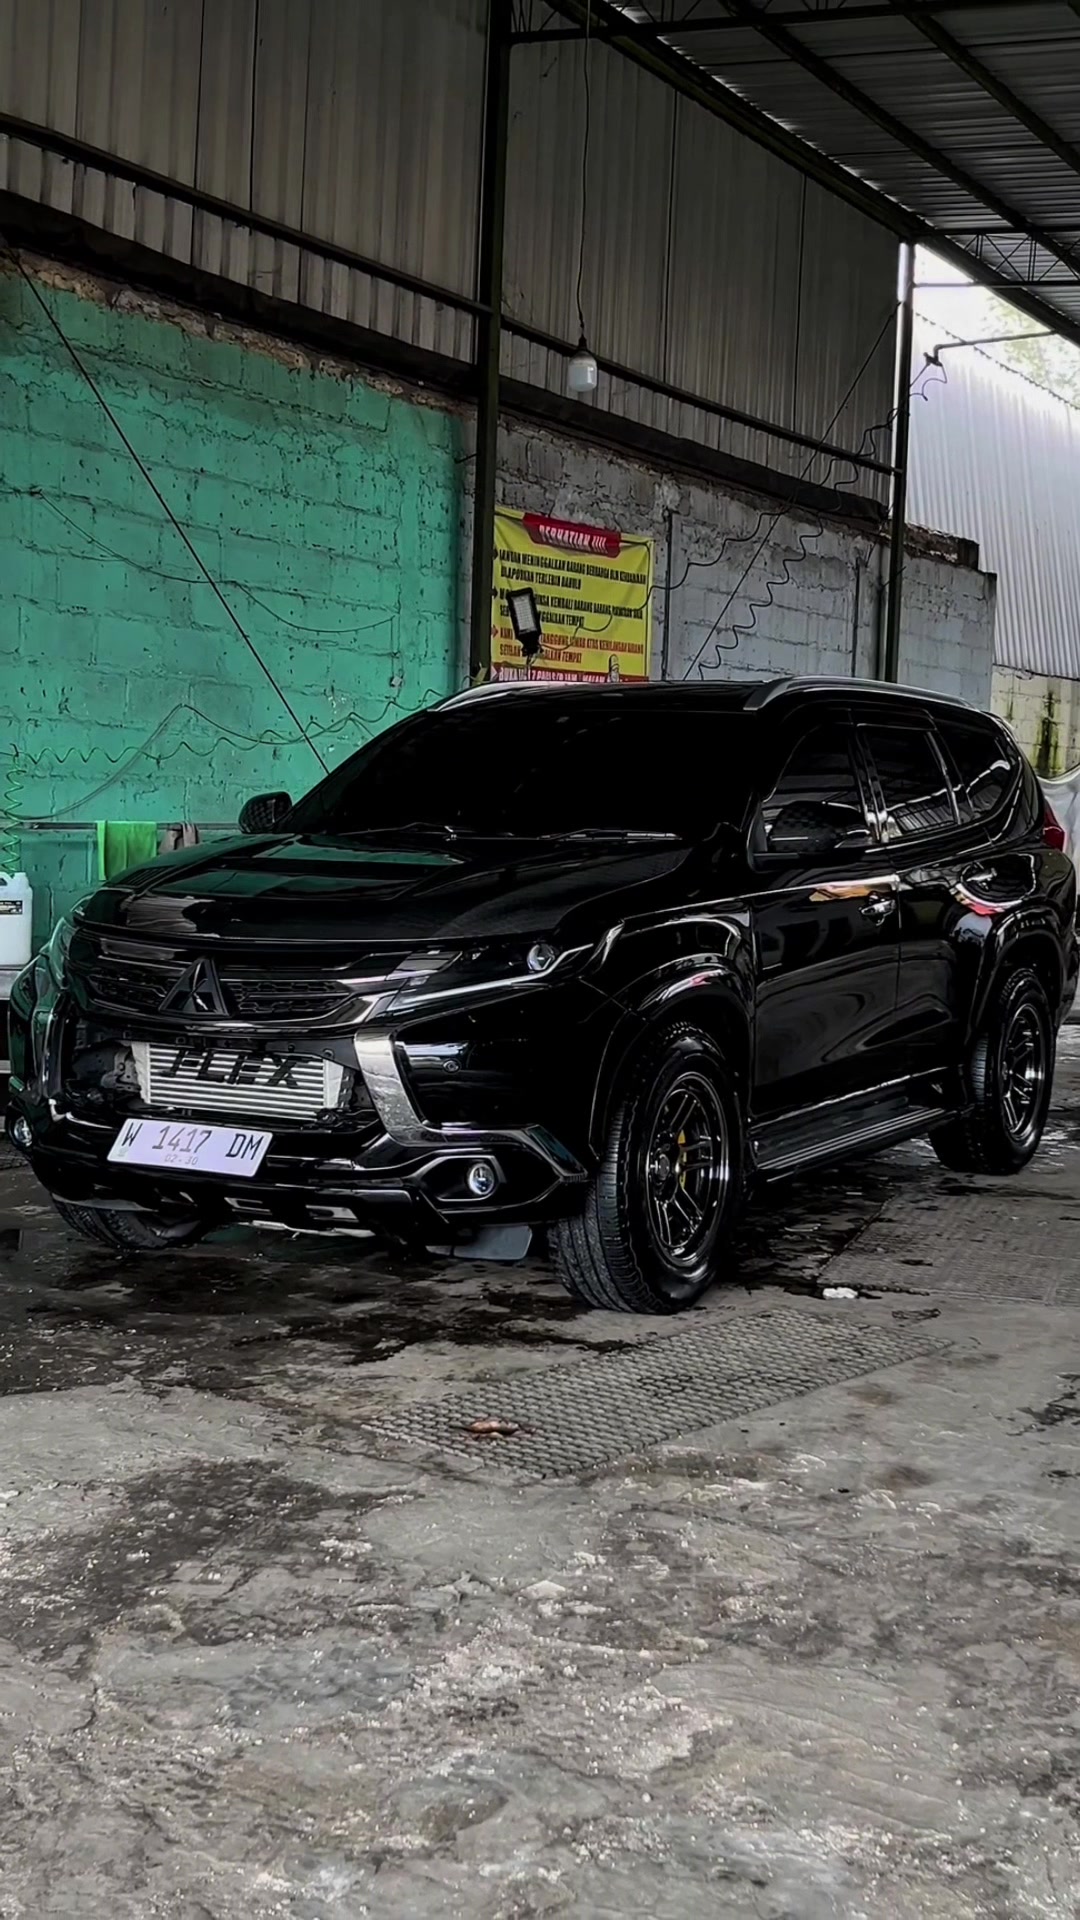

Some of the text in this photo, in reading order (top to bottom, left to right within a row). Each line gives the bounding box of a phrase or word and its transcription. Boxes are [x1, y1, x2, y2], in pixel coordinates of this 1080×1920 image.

[120, 1122, 265, 1161] W 1417 DM
